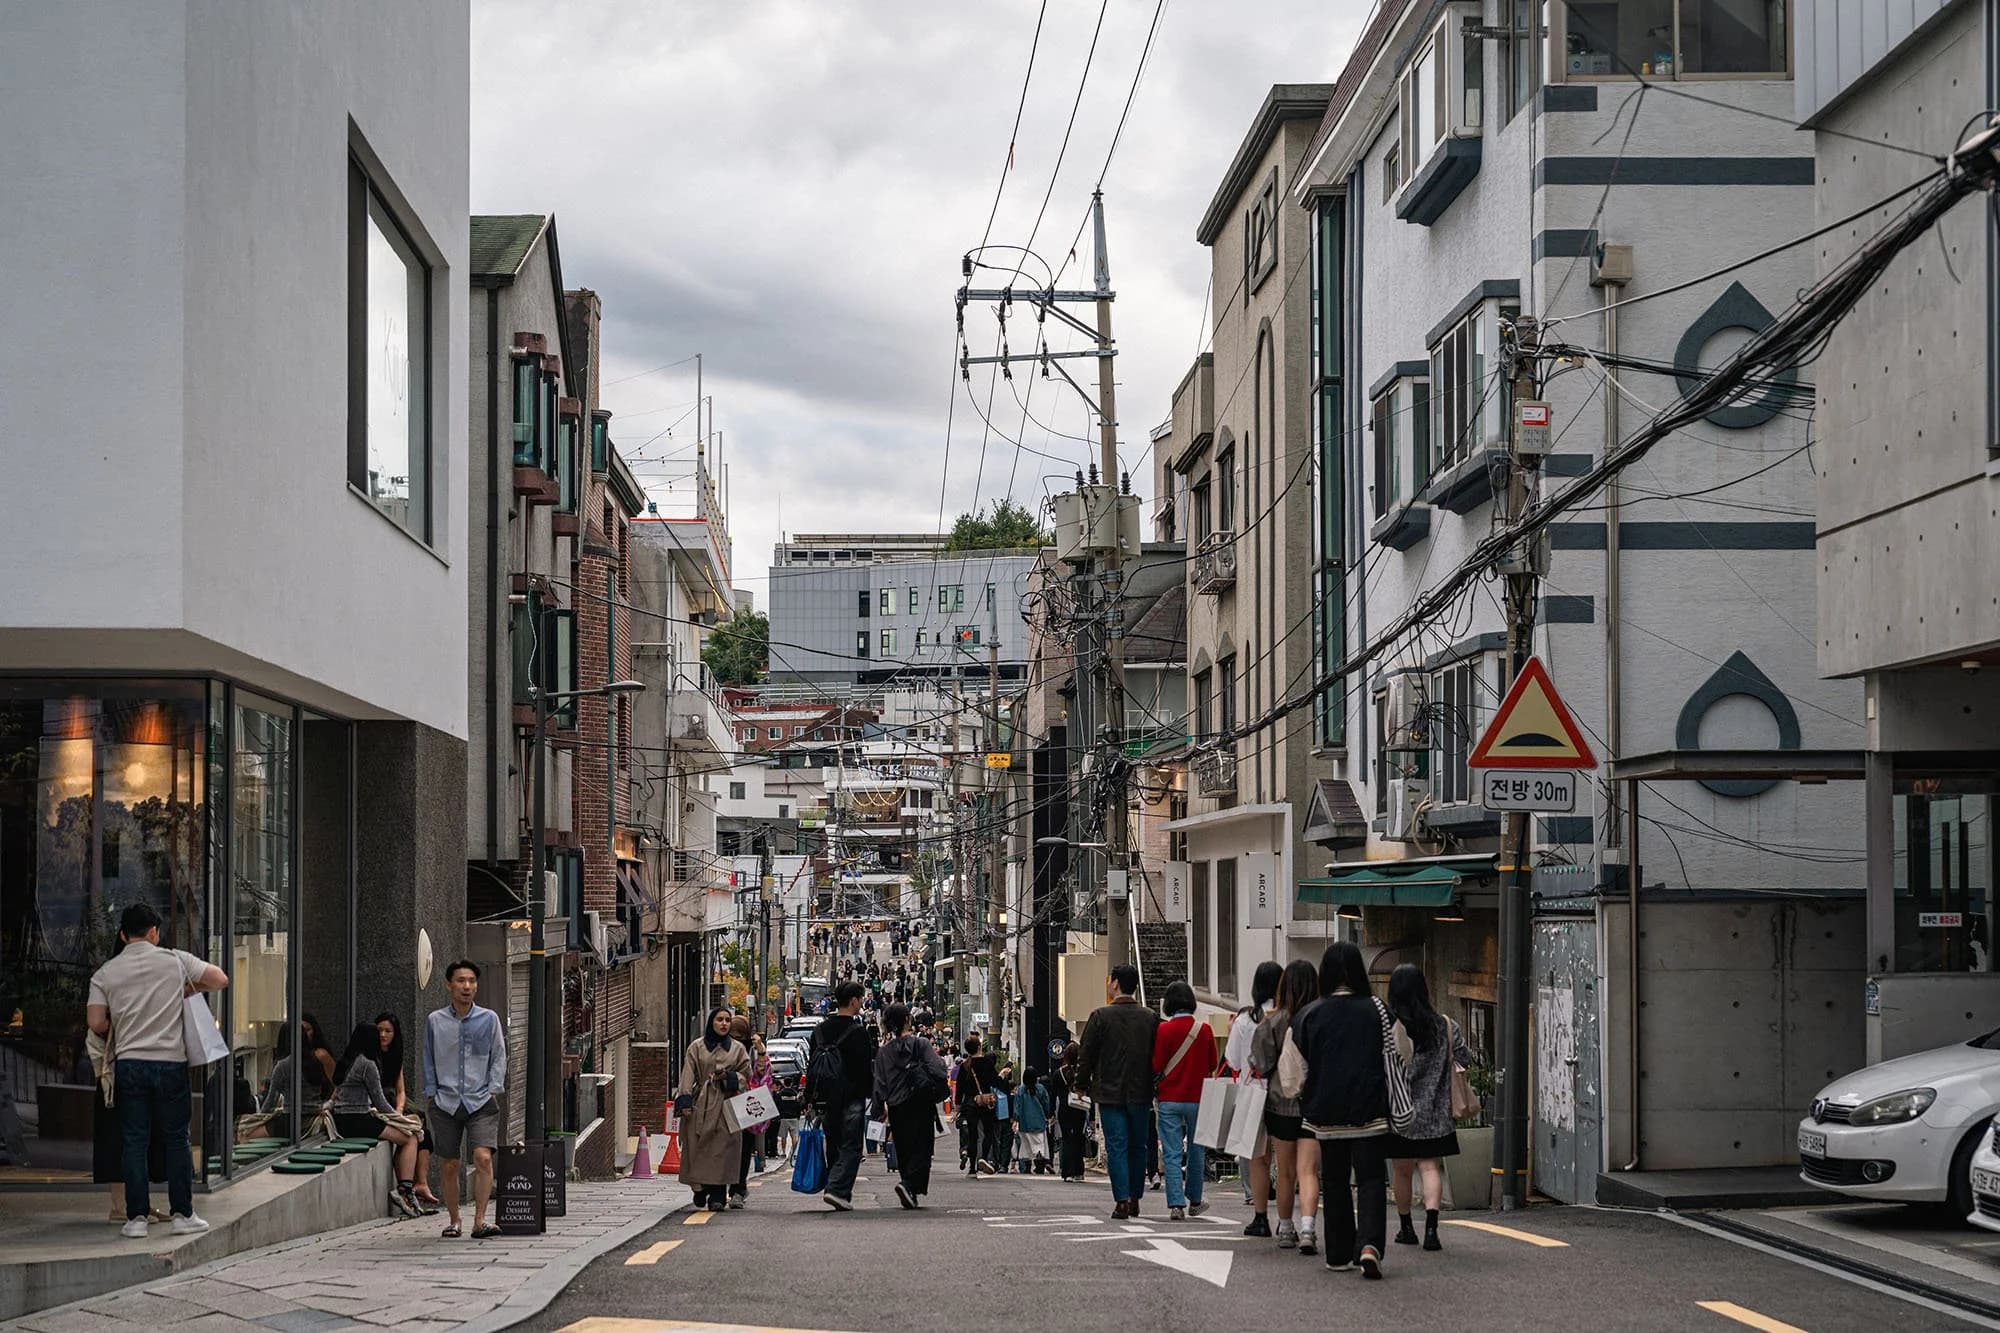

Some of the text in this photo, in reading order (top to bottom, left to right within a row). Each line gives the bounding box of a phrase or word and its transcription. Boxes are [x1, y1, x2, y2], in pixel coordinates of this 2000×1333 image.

[1491, 779, 1568, 802] 전방 30m
[1258, 873, 1266, 909] ARCADE
[507, 1182, 532, 1191] POND
[507, 1199, 529, 1207] COFFEE
